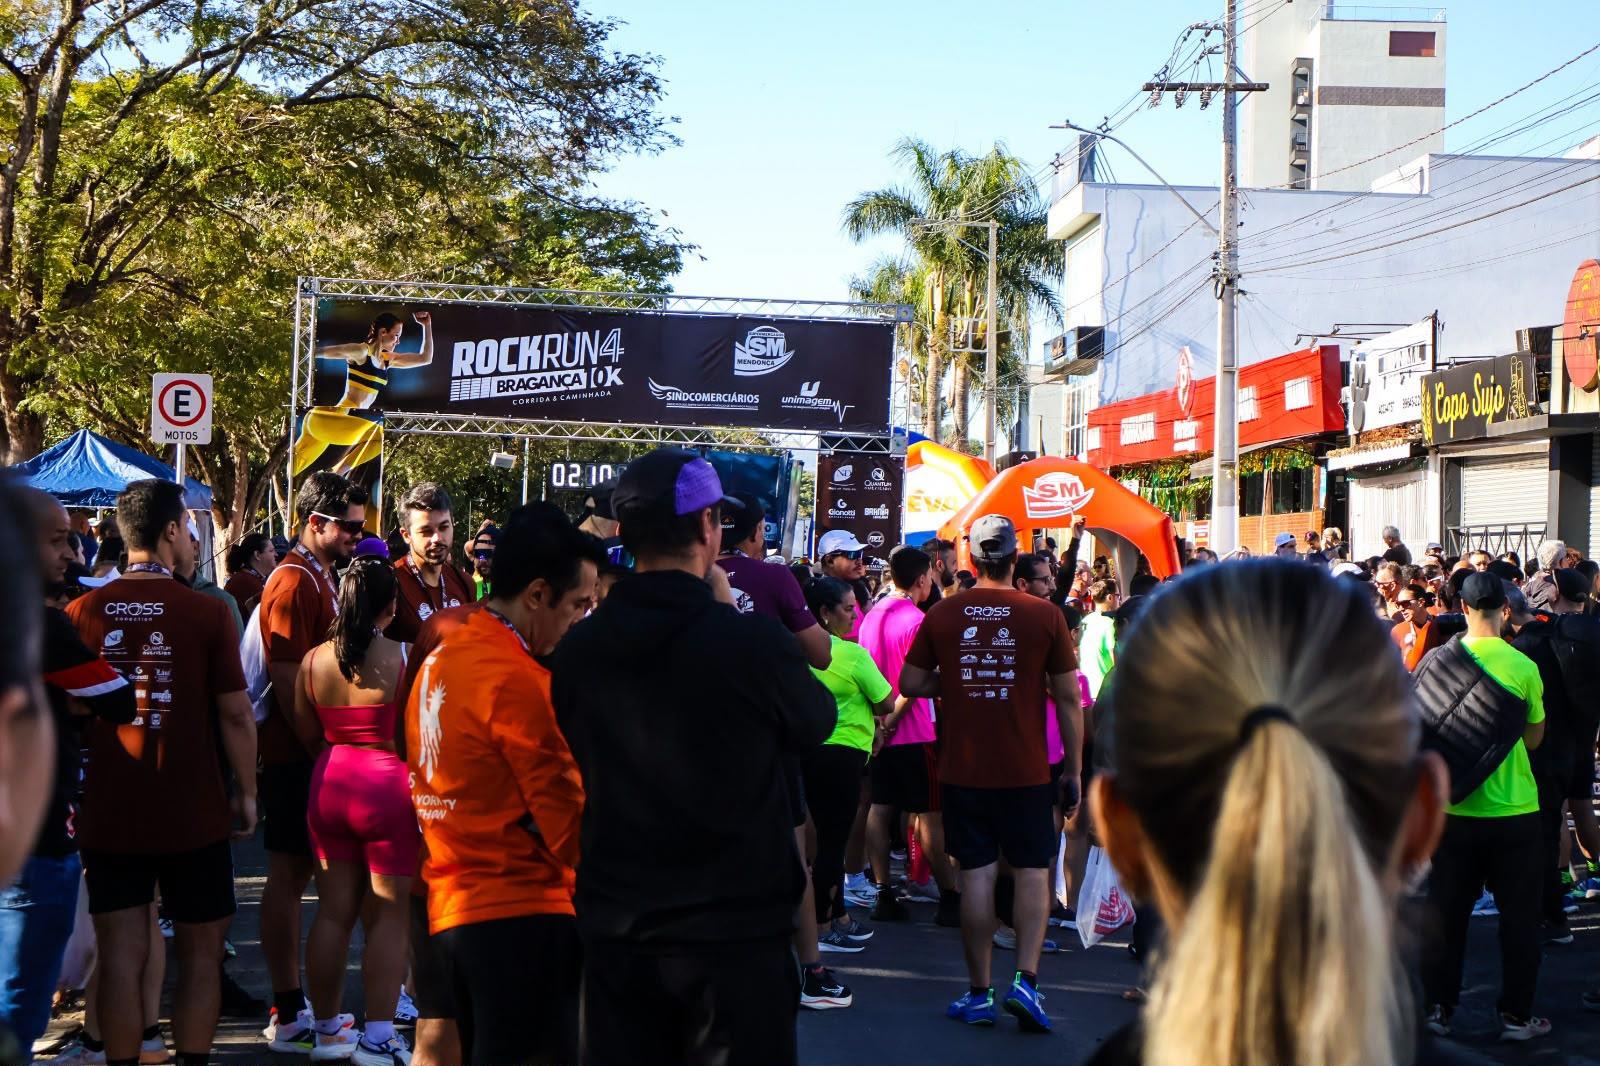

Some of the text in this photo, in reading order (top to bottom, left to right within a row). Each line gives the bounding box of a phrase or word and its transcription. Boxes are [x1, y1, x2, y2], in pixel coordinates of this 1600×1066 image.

[749, 337, 785, 357] SM
[496, 372, 583, 394] BRAGANÇA
[174, 390, 191, 417] E
[512, 396, 550, 406] CORRIDA
[560, 390, 612, 401] CAMINHADA
[666, 391, 760, 404] SINDCOMERCIÁRIOS
[1435, 372, 1505, 438] Copo Sujo
[165, 431, 198, 440] MOTOS
[1039, 482, 1080, 498] SM
[105, 602, 164, 616] CROSS
[964, 606, 1011, 617] CROSS
